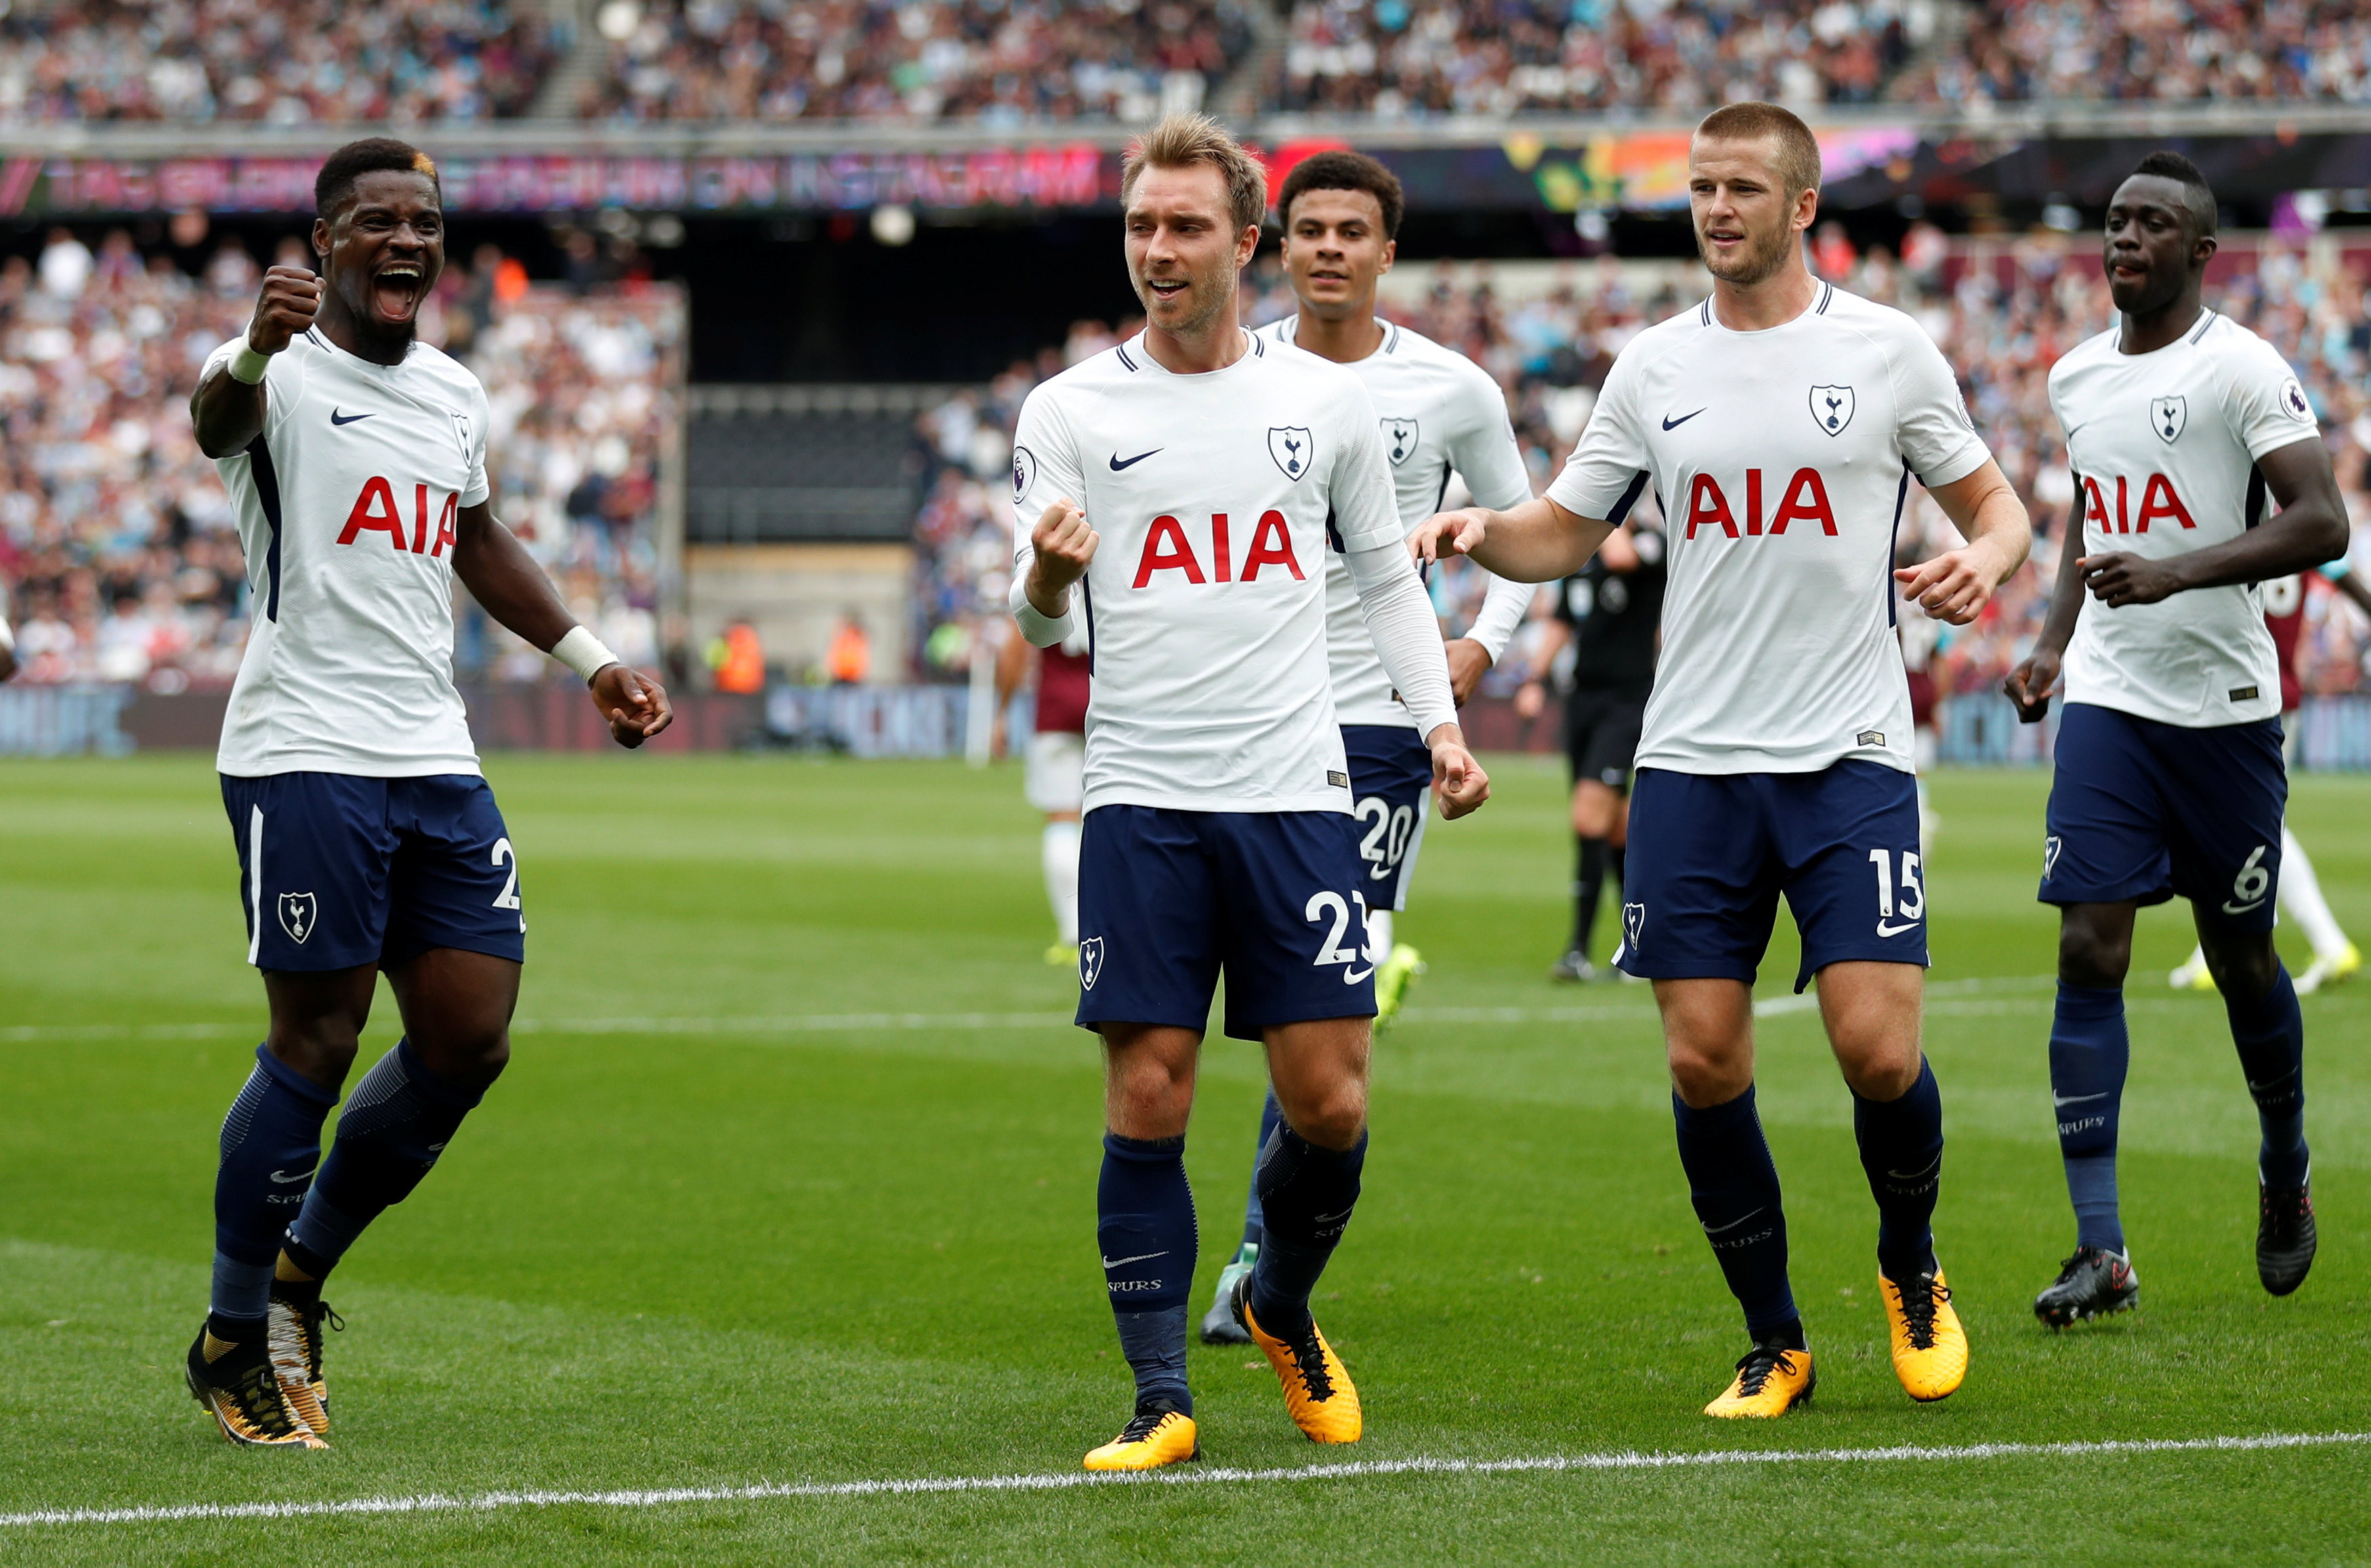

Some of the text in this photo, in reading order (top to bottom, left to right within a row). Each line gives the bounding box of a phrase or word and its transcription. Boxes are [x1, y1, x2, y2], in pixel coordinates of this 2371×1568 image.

[337, 475, 457, 557] AIA
[1687, 468, 1839, 540] AIA
[2084, 474, 2196, 534] AIA
[1132, 509, 1306, 589] AIA
[1354, 797, 1413, 867] 20
[1868, 849, 1924, 920] 15
[2234, 845, 2268, 902] 6
[2058, 1116, 2105, 1136] SPURS
[266, 1191, 309, 1204] SPU
[1108, 1279, 1162, 1292] SPURS
